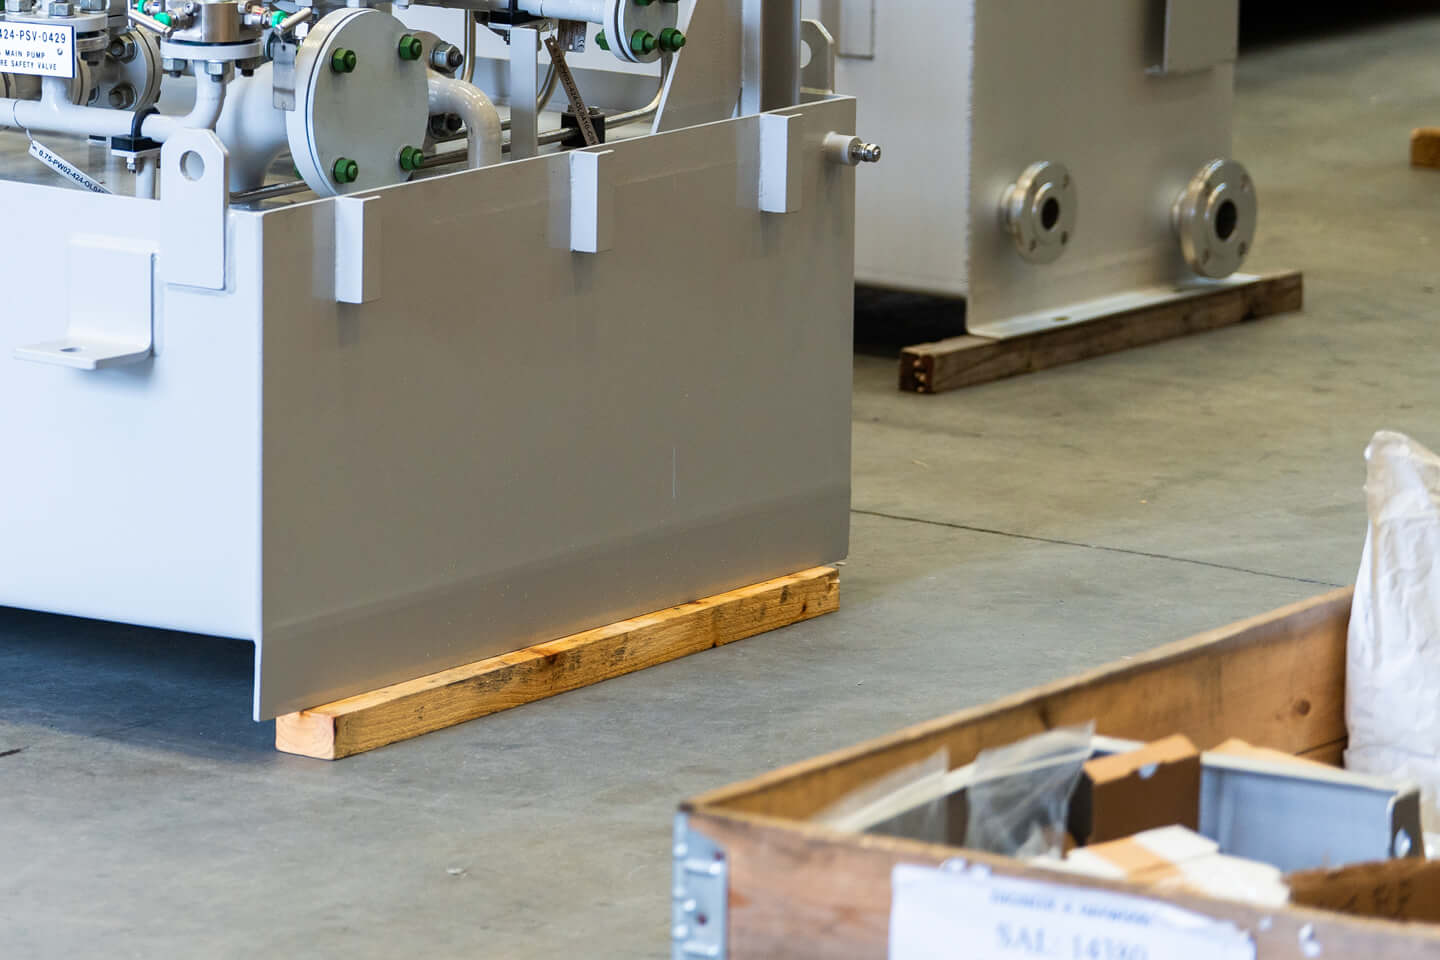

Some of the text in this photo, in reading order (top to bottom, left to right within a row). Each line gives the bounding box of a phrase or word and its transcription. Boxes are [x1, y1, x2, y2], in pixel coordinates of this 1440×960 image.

[5, 49, 23, 57] MAIN
[26, 51, 46, 59] PUMP
[10, 60, 34, 69] SAFETY
[37, 62, 57, 71] VALVE
